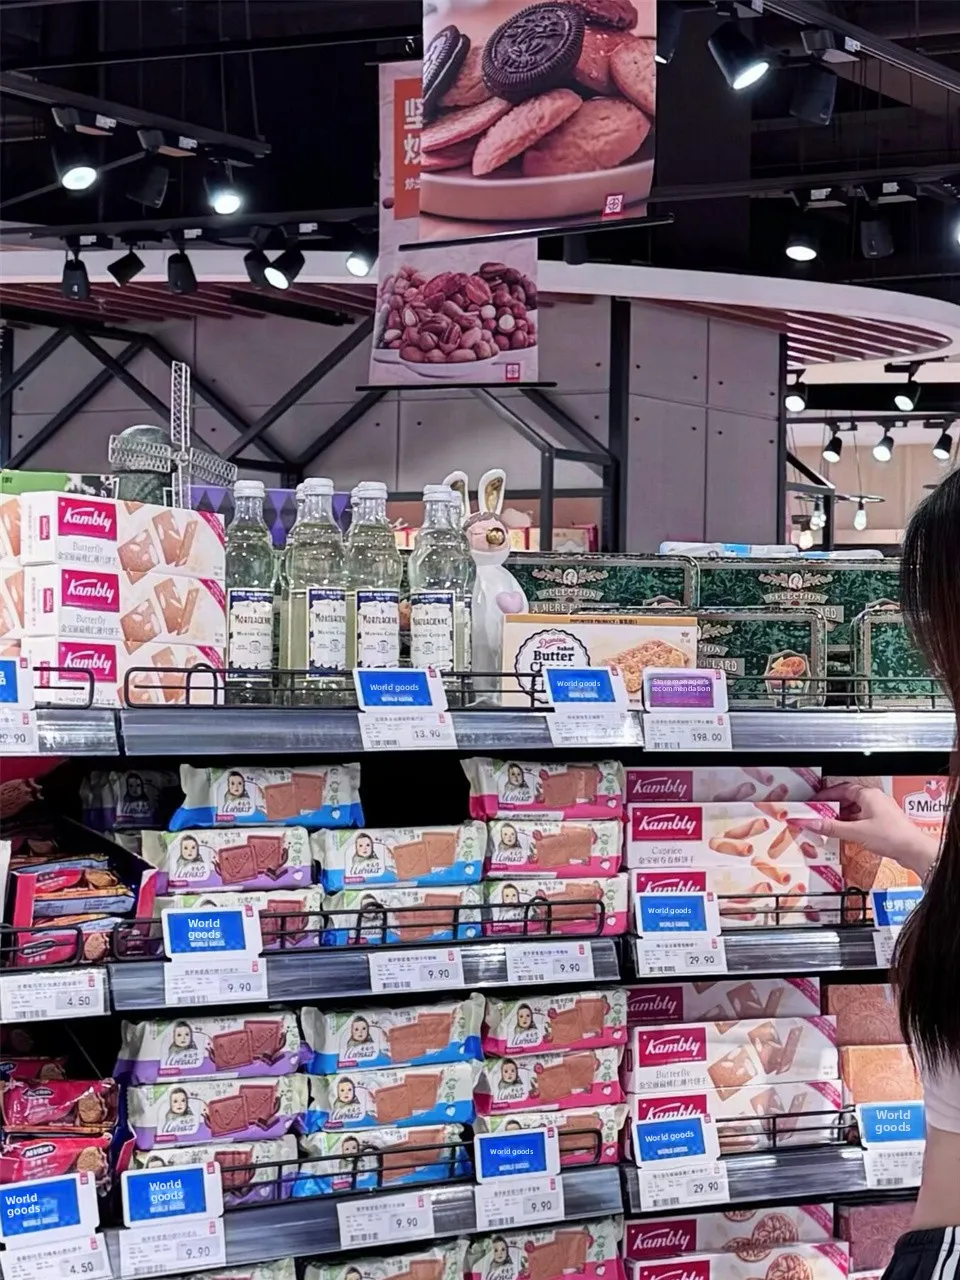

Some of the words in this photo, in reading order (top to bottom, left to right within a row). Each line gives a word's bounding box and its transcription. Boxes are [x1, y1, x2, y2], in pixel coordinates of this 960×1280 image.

[63, 506, 112, 533] Kambly
[533, 650, 575, 663] Butter
[63, 652, 112, 678] Kambly
[699, 658, 738, 672] OULARD
[370, 683, 392, 692] World
[394, 683, 419, 694] goods
[575, 680, 601, 689] goods
[652, 684, 711, 692] recommendation
[414, 729, 441, 739] 13.90
[692, 732, 723, 742] 198.00
[633, 777, 688, 796] Kambly
[637, 814, 697, 834] Kambly
[651, 846, 683, 857] Caprice
[648, 907, 668, 915] World
[669, 907, 692, 917] goods
[188, 918, 220, 928] World
[188, 929, 221, 941] goods
[560, 963, 580, 973] 9.90
[227, 982, 252, 993] 9.90
[66, 995, 91, 1006] 4.50
[645, 1036, 701, 1056] Kambly
[645, 1134, 668, 1143] World
[670, 1131, 694, 1143] goods
[510, 1148, 533, 1158] goods
[149, 1180, 182, 1191] World
[151, 1191, 183, 1203] goods
[531, 1201, 552, 1212] 9.90
[69, 1262, 94, 1274] 4.50
